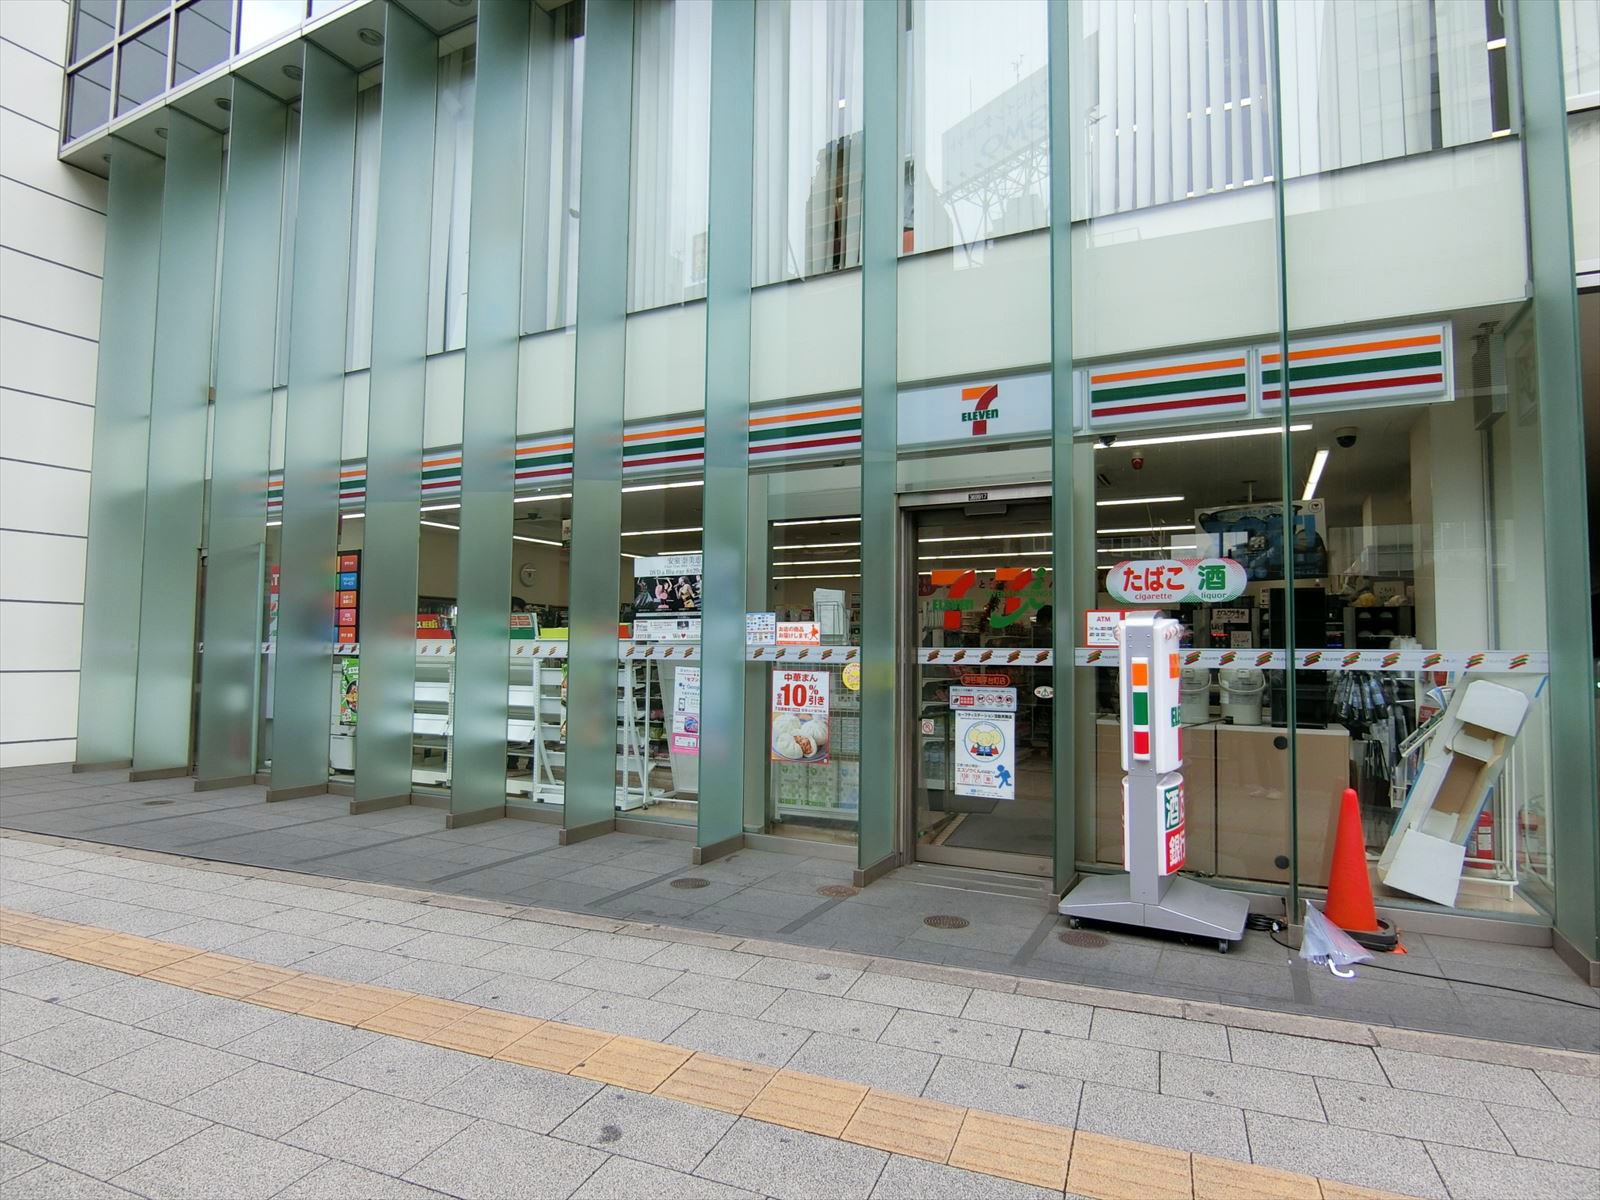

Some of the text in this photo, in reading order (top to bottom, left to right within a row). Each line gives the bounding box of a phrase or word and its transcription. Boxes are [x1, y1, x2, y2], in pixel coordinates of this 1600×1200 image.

[1123, 565, 1226, 592] たばこ 酒
[1134, 592, 1227, 602] cigarette liquor
[784, 673, 818, 682] 中華まん
[780, 683, 807, 707] 10
[1166, 789, 1180, 828] 酒
